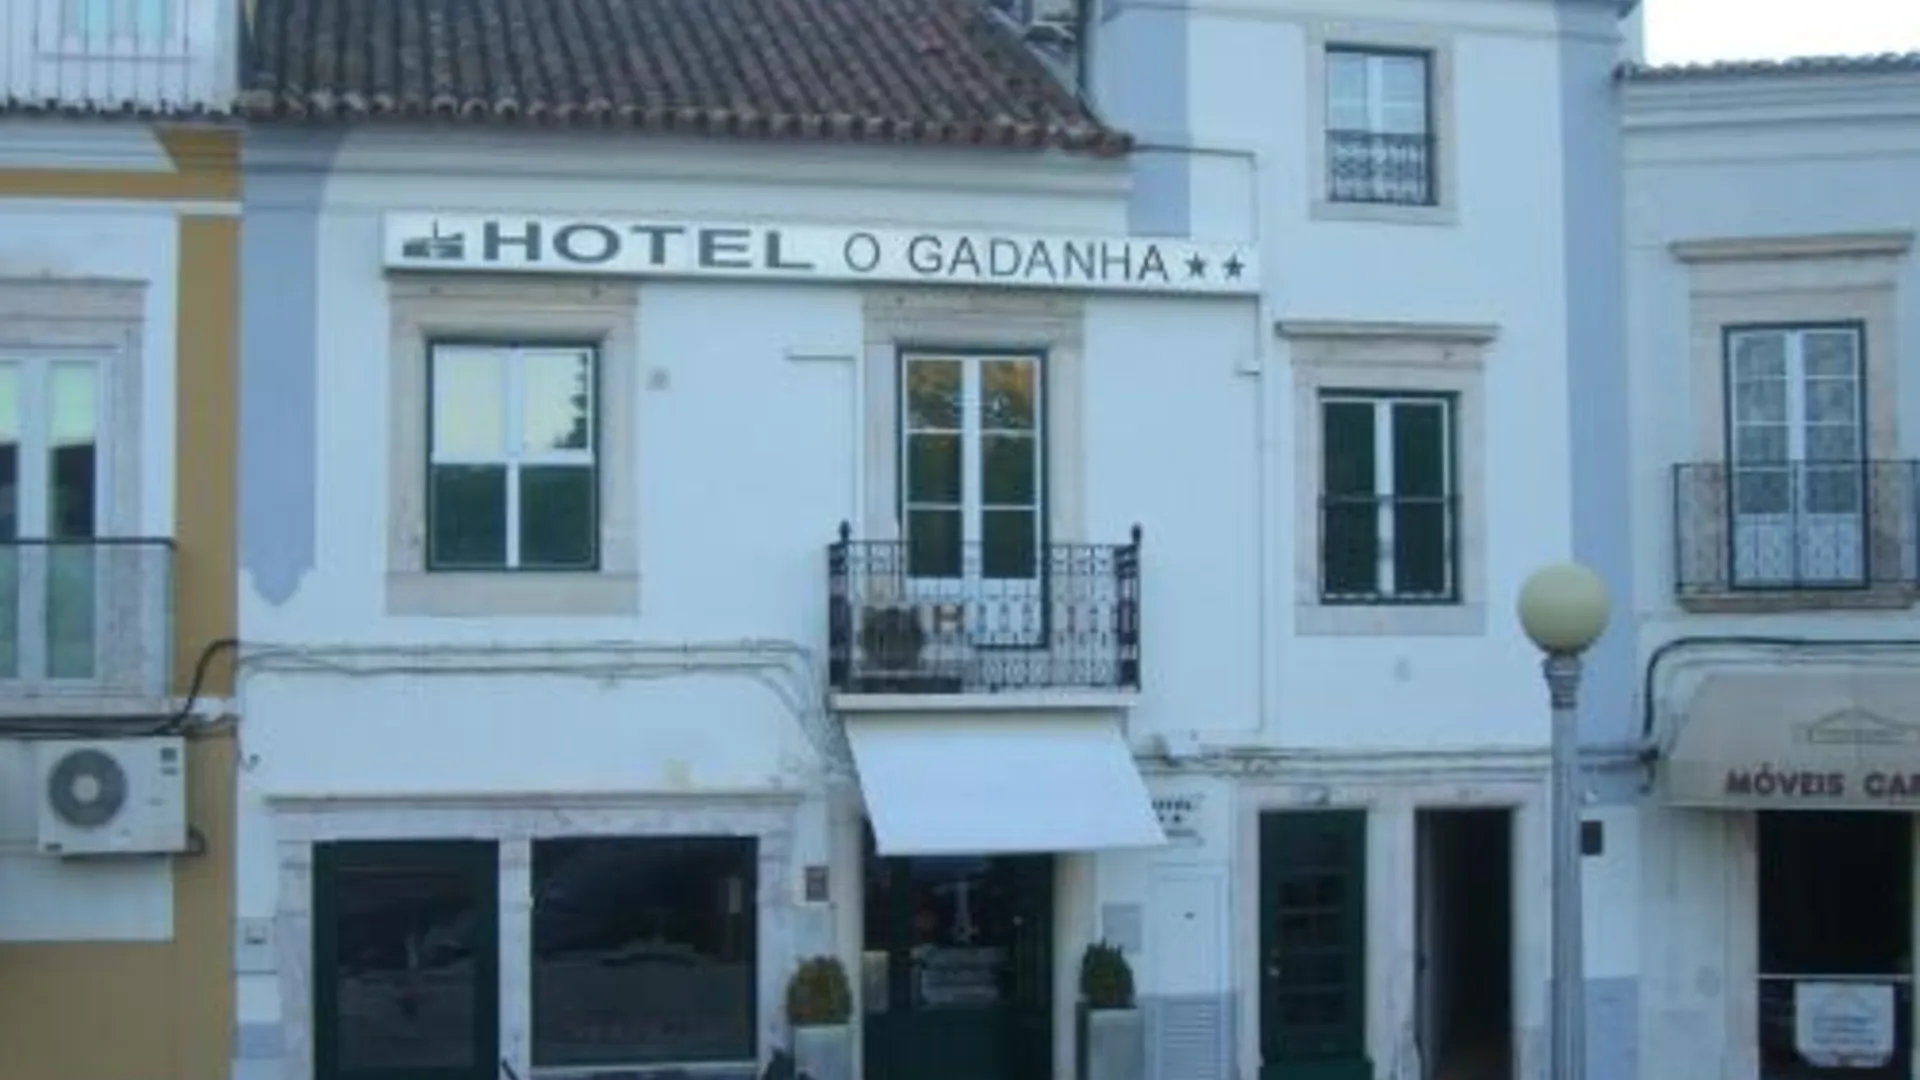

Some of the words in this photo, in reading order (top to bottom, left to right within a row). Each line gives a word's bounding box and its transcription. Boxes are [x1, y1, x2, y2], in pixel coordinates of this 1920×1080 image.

[483, 221, 816, 269] HOTEL
[843, 232, 880, 272] O
[907, 234, 1170, 282] GADANHA
[1726, 760, 1845, 795] MÓVEIS
